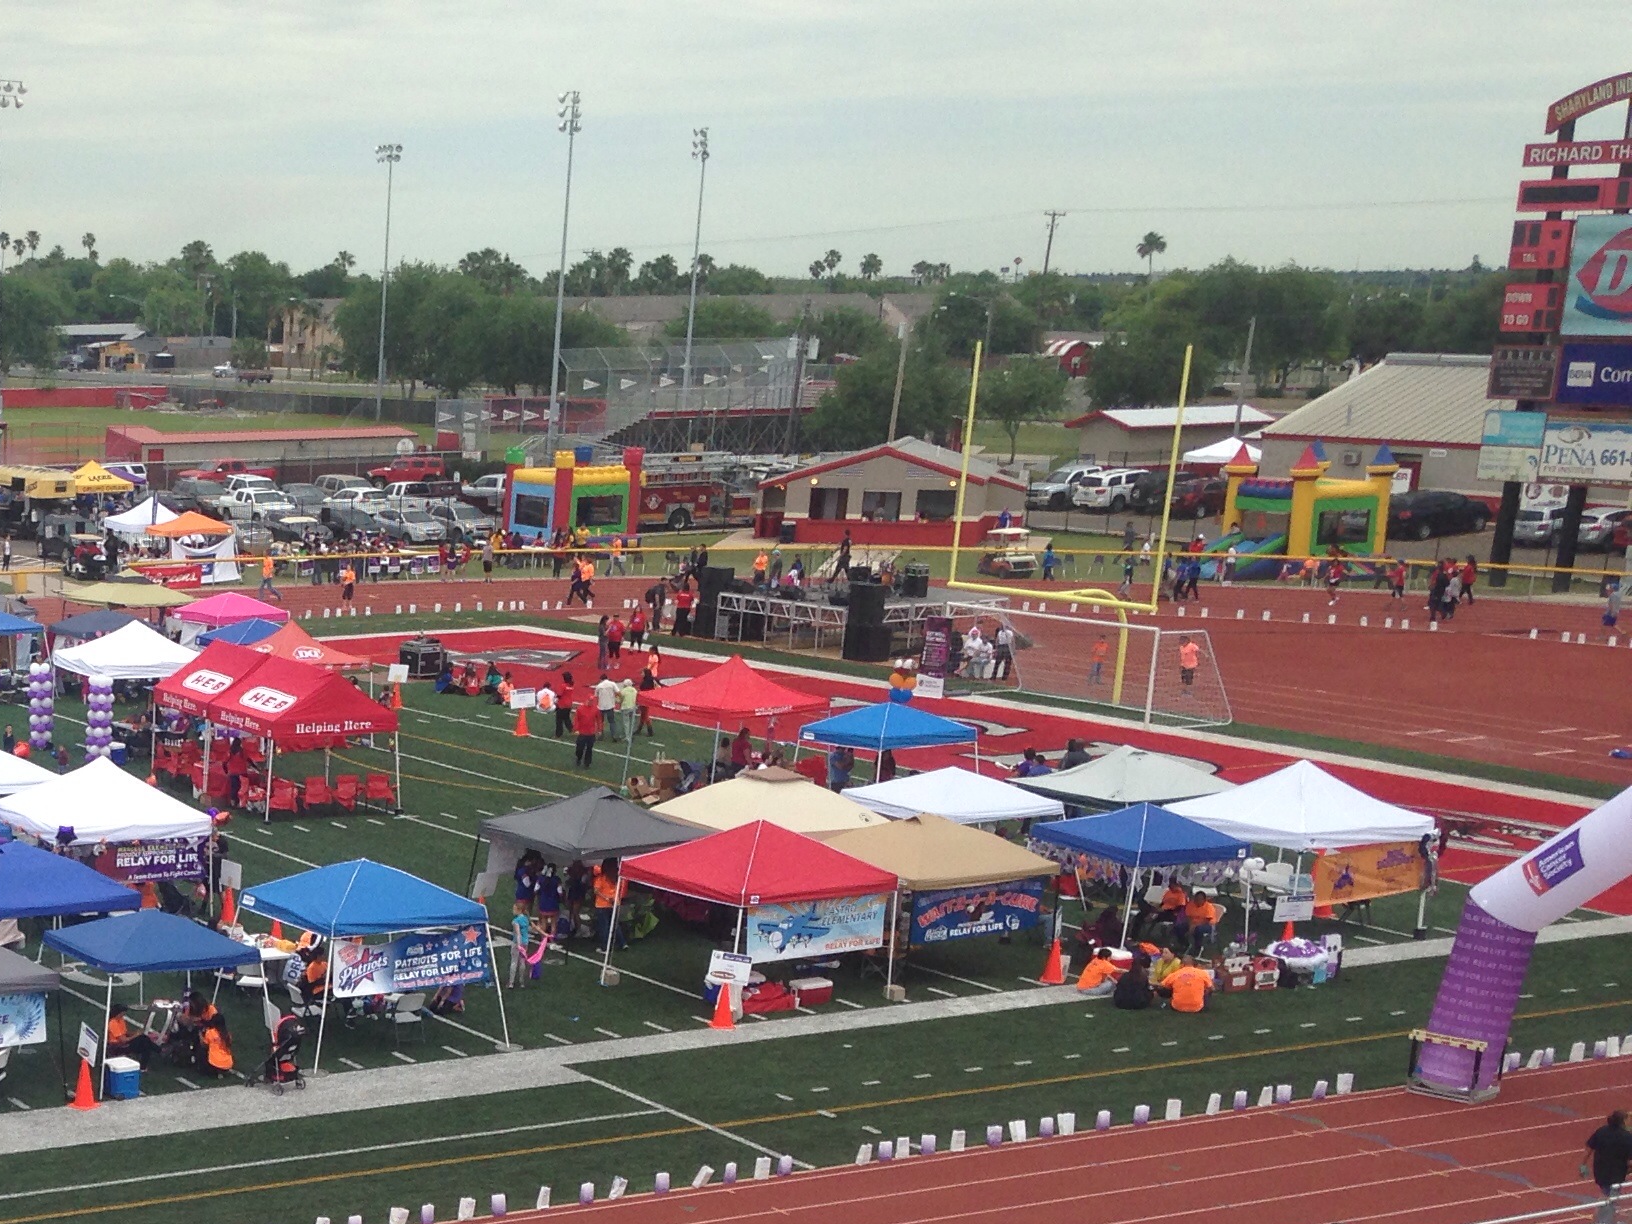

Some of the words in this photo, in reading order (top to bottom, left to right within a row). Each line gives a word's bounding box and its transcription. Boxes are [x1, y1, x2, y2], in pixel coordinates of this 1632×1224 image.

[1554, 82, 1613, 122] SHARYLAND
[1530, 145, 1603, 163] RICHARD
[1505, 292, 1532, 303] DOWN
[1504, 314, 1515, 325] TO
[1516, 314, 1529, 325] GO
[163, 692, 183, 710] Helping
[220, 710, 244, 728] Helping
[295, 721, 341, 735] Helping
[116, 856, 152, 868] RELAY
[153, 854, 176, 865] FOR
[1538, 841, 1575, 868] American
[1540, 853, 1567, 873] Cancer
[1542, 859, 1573, 880] Society
[820, 910, 878, 926] ELEMENTARY
[949, 927, 971, 937] RELAY
[972, 925, 987, 934] FOR
[987, 922, 1004, 931] LIFE
[825, 941, 847, 951] RELAY
[848, 938, 864, 948] FOR
[394, 953, 438, 969] PATRIOTS
[440, 950, 462, 961] FOR
[464, 946, 483, 958] LIFE
[339, 956, 388, 987] Patriots
[393, 970, 419, 981] RELAY
[421, 968, 440, 977] FOR
[440, 964, 459, 975] LIFE
